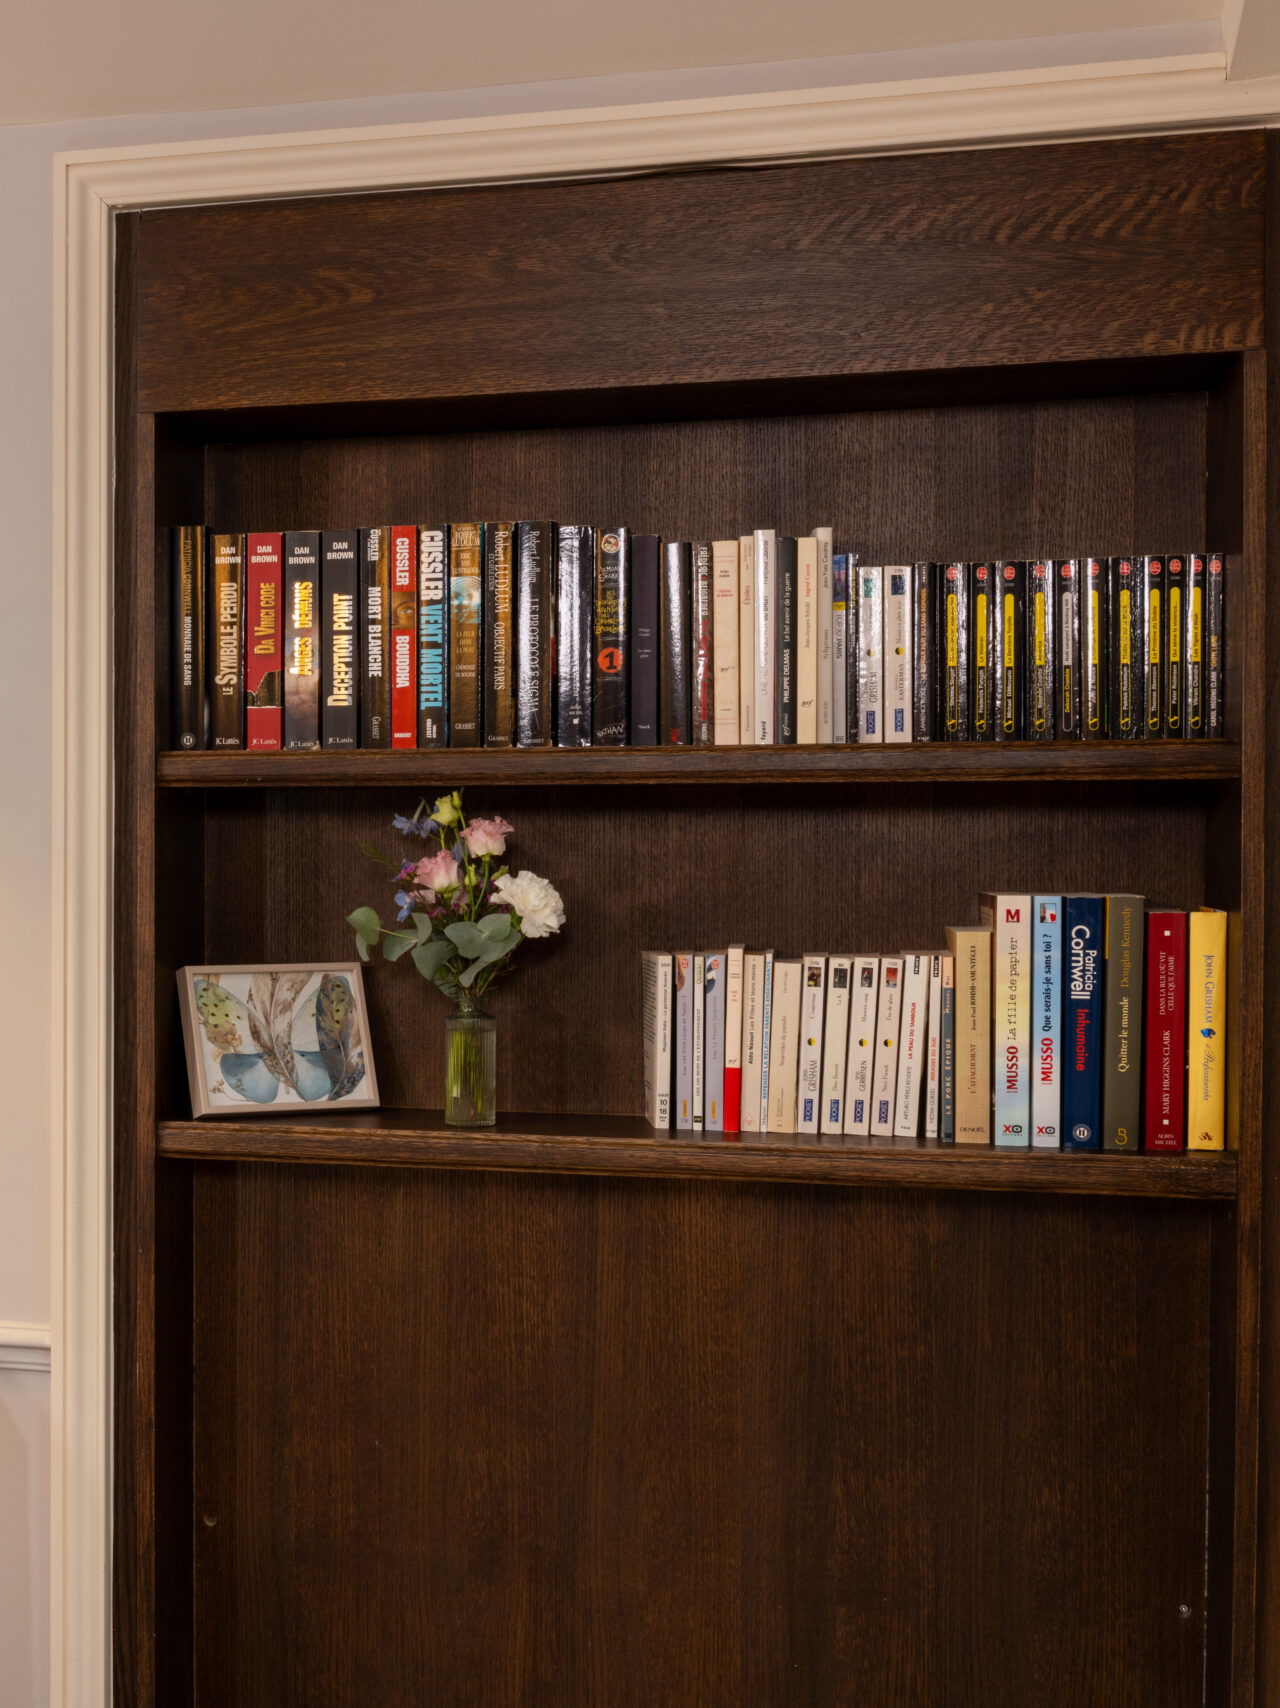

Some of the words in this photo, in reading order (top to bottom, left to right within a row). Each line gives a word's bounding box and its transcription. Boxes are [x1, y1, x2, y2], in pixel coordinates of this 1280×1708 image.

[220, 546, 236, 555] DAN
[256, 545, 272, 554] DAN
[294, 546, 310, 555] DAN
[332, 541, 348, 550] DAN
[370, 529, 379, 561] CUSSLER
[494, 531, 509, 561] Robert
[529, 530, 540, 553] Robert
[184, 540, 192, 572] PATRICIA
[215, 556, 241, 565] BROWN
[251, 555, 278, 564] BROWN
[288, 556, 315, 565] BROWN
[326, 551, 354, 560] BROWN
[395, 537, 410, 586] CUSSLER
[420, 530, 444, 601] CUSSLER
[529, 556, 540, 583] Ludlum
[184, 574, 192, 615] CORNWELL
[260, 582, 276, 607] CODE
[494, 564, 509, 613] LUDLUM
[220, 582, 238, 622] PERDU
[333, 593, 353, 631] POINT
[368, 586, 382, 620] MORT
[783, 598, 790, 606] de
[183, 616, 192, 652] MONNAIE
[420, 604, 443, 644] VENT
[215, 625, 238, 685] SYMBOLE
[368, 624, 382, 678] BLANCHE
[494, 621, 506, 664] OBJECTIF
[528, 614, 539, 677] PROTOCOLE
[183, 653, 192, 663] DE
[289, 637, 313, 676] ANGES
[395, 635, 410, 688] BOUDDHA
[604, 651, 618, 670] 1
[183, 664, 192, 686] SANG
[327, 634, 353, 706] DECEPTION
[420, 648, 443, 710] MORTEL
[494, 666, 506, 690] PARIS
[222, 687, 234, 696] LE
[596, 724, 624, 738] NATHAN
[1006, 909, 1020, 923] M
[1121, 906, 1133, 947] Kennedy
[1009, 937, 1020, 978] papier
[1042, 941, 1051, 953] toi
[1070, 924, 1091, 1000] Cornwell
[1084, 949, 1098, 991] Patricia
[1120, 949, 1132, 988] Douglas
[1158, 963, 1166, 973] OÙ
[1167, 955, 1175, 976] J'AIME
[1203, 954, 1215, 979] JOHN
[1008, 979, 1017, 992] de
[1042, 977, 1053, 1013] serais-je
[1159, 989, 1166, 997] LA
[1167, 977, 1175, 991] QUE
[1008, 994, 1017, 1025] fille
[1119, 997, 1129, 1028] monde
[1167, 992, 1175, 1011] CELLE
[1205, 982, 1216, 1023] GRISHAM
[909, 1029, 915, 1037] DU
[1008, 1028, 1016, 1041] La
[1042, 1015, 1052, 1032] Que
[1119, 1028, 1129, 1038] le
[1075, 1009, 1090, 1071] Inhumaine
[1162, 1030, 1170, 1056] CLARK
[908, 1052, 914, 1060] LA
[930, 1049, 936, 1057] DU
[1041, 1037, 1053, 1082] MUSSO
[1118, 1039, 1130, 1073] Quitter
[808, 1060, 818, 1092] GRISHAM
[859, 1060, 868, 1092] GERRITSEN
[1006, 1046, 1019, 1090] MUSSO
[1162, 1057, 1170, 1091] HIGGINS
[803, 1099, 814, 1123] POCKET
[830, 1099, 840, 1124] POCKET
[853, 1099, 864, 1124] POCKET
[878, 1100, 889, 1125] POCKET
[945, 1105, 951, 1115] LE
[1162, 1091, 1170, 1114] MARY
[1003, 1124, 1023, 1134] XO
[1036, 1126, 1056, 1135] XO
